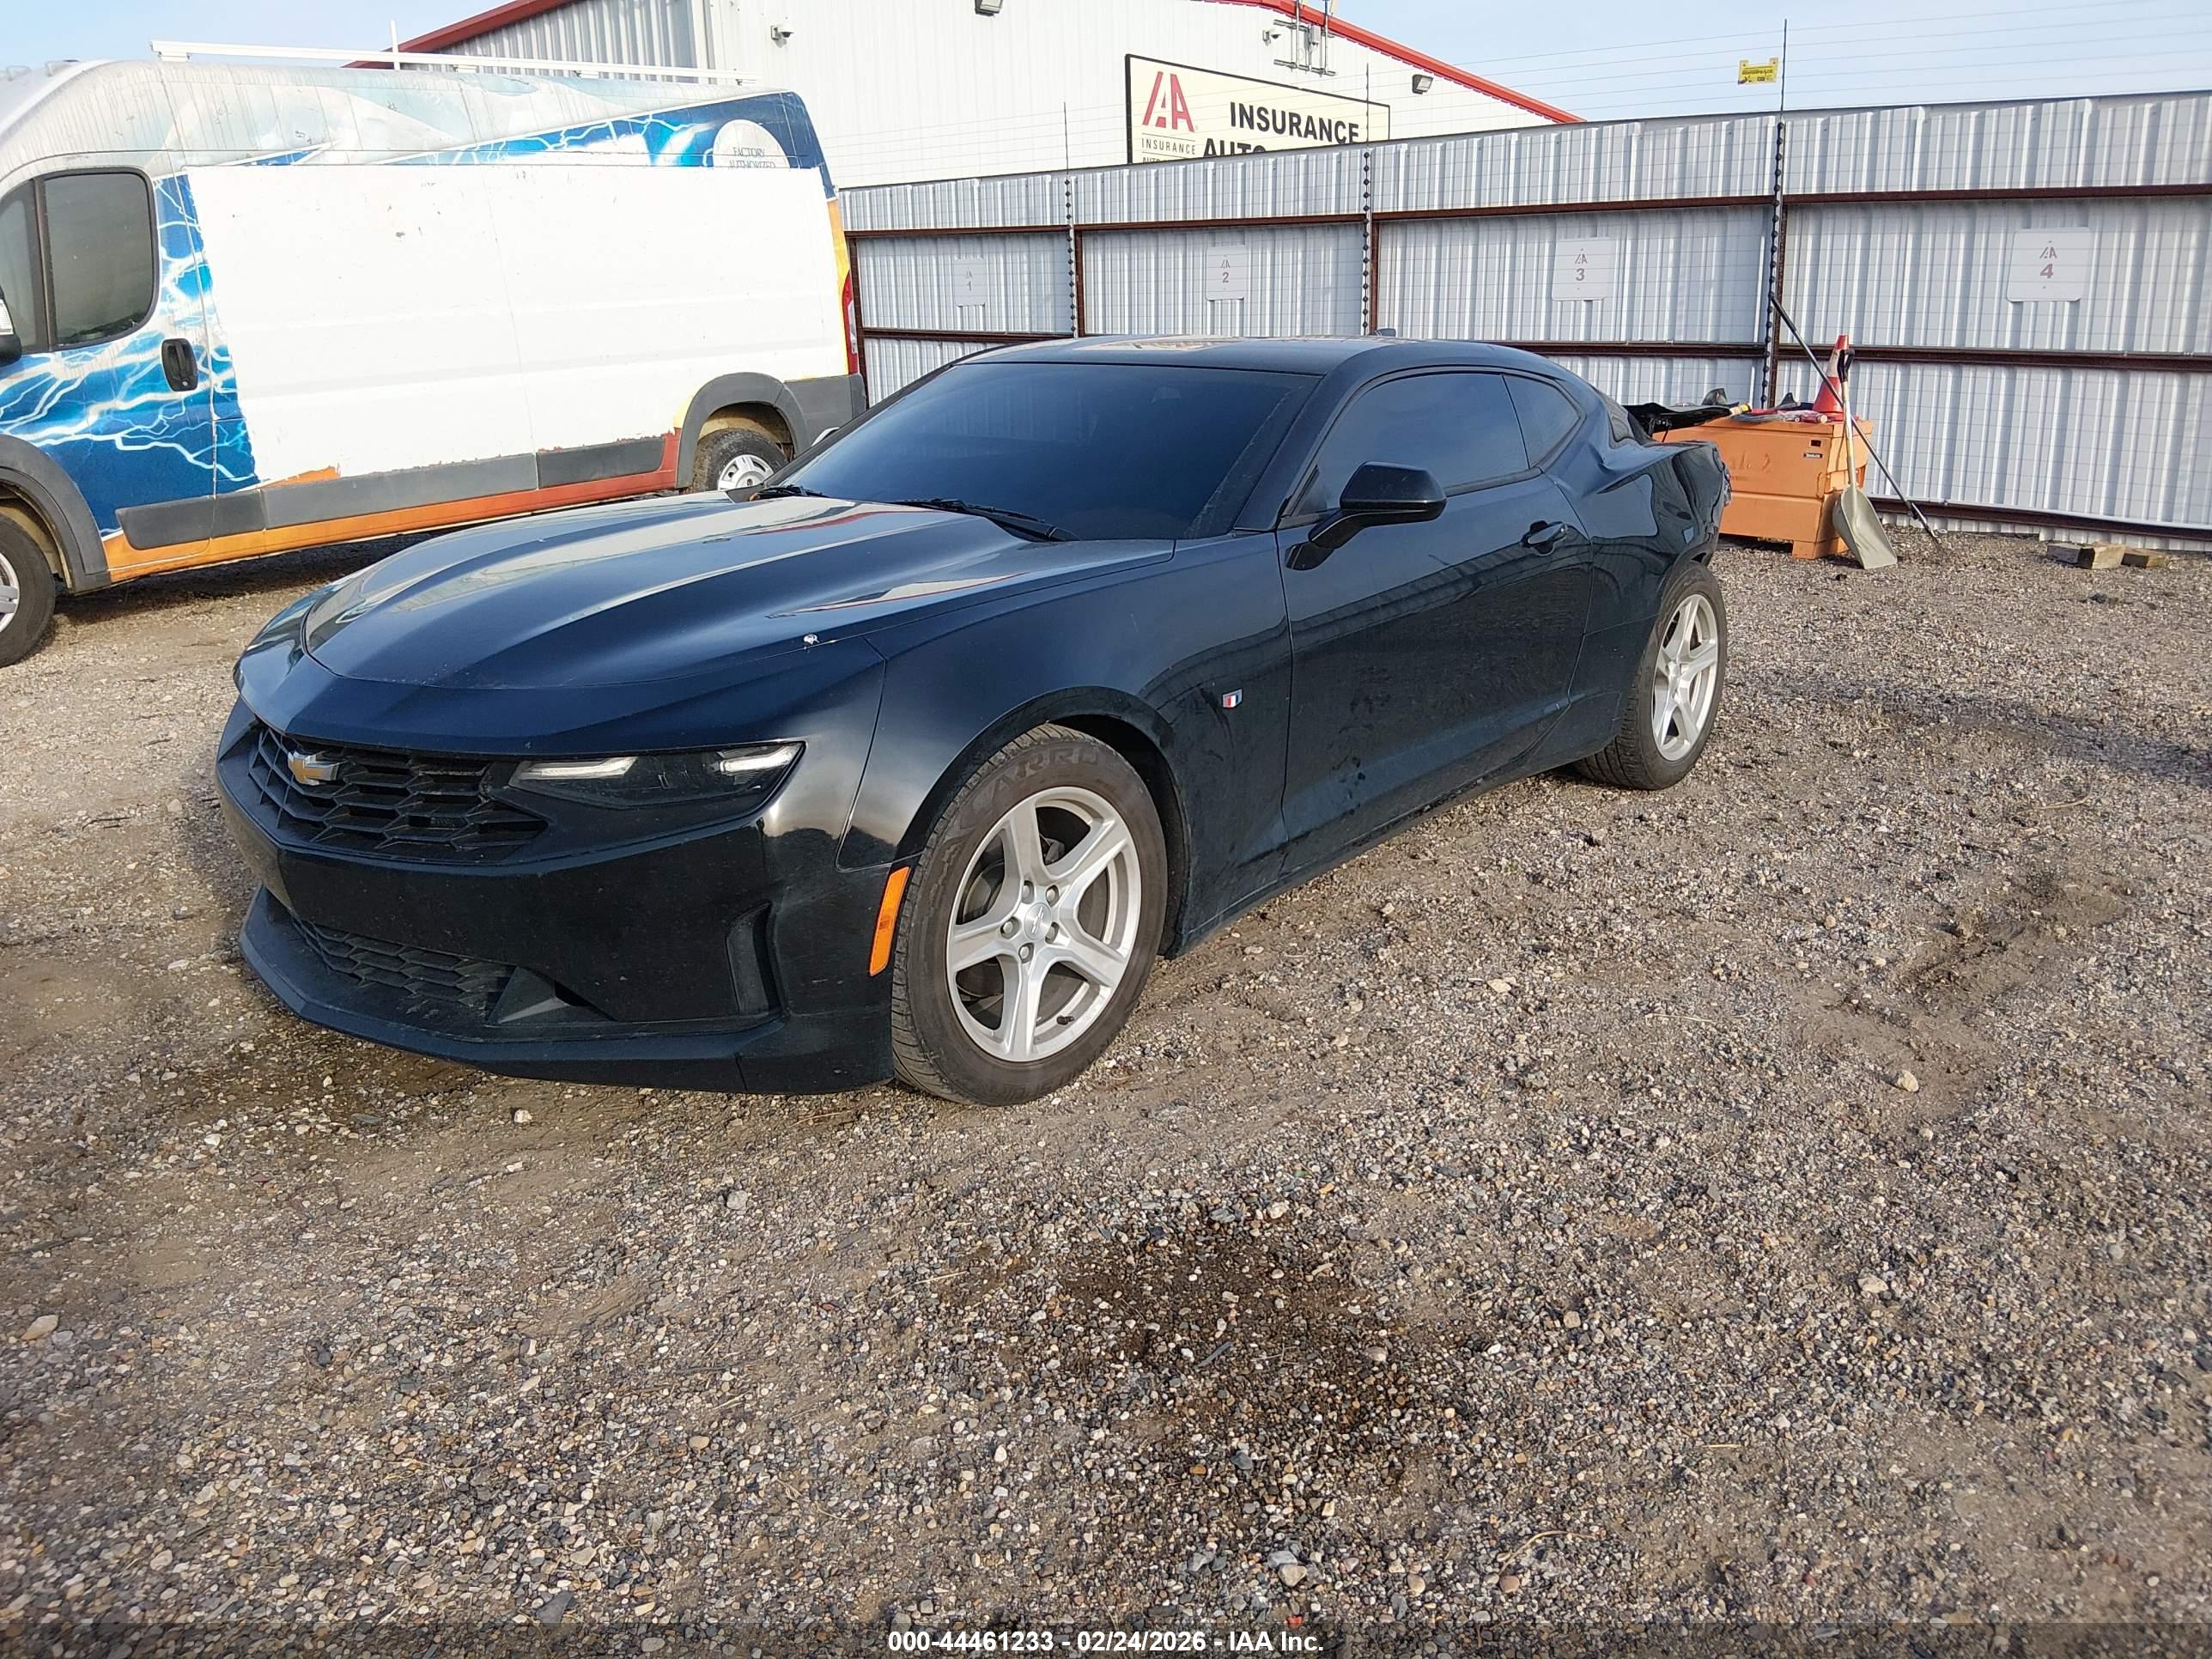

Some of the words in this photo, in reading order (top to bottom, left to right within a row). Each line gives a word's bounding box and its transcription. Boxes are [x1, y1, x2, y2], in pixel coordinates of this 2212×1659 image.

[1230, 100, 1359, 143] INSURANCE
[732, 147, 765, 157] FACTORY
[1141, 137, 1196, 155] INSURANCE
[1222, 271, 1230, 283] 2
[1575, 268, 1585, 282] 3
[2039, 263, 2054, 279] 4
[966, 281, 972, 292] 1
